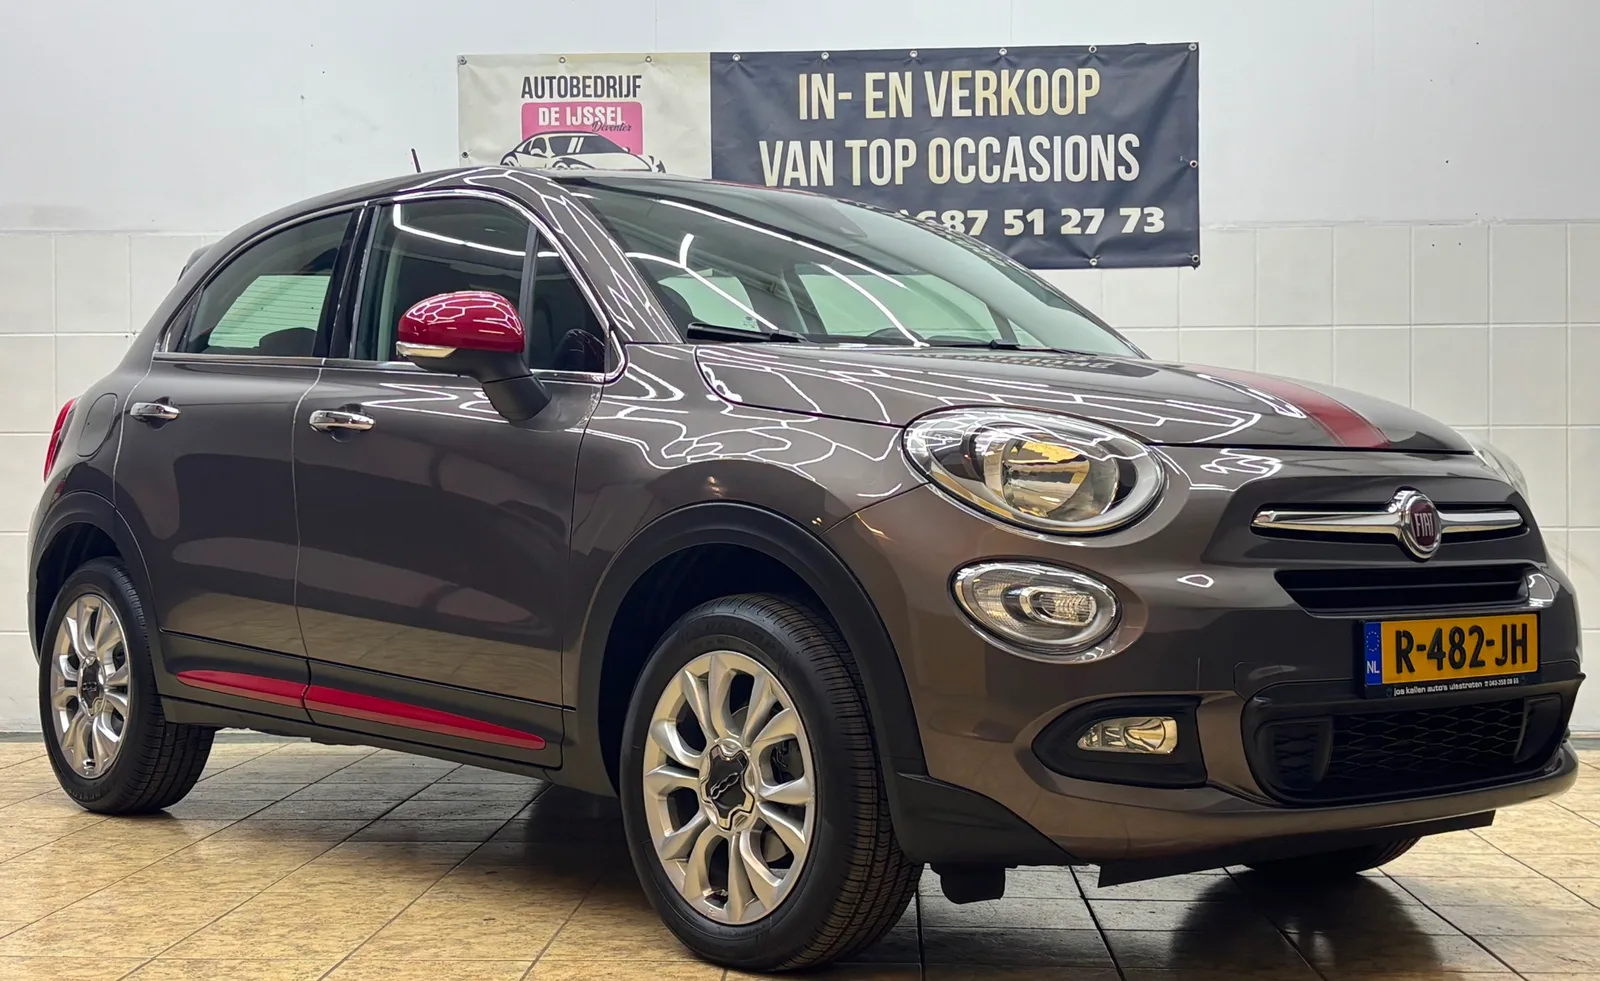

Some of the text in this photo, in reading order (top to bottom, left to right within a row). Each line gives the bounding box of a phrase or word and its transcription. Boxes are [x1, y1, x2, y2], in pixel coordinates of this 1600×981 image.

[521, 75, 642, 98] AUTOBEDRIJF
[798, 68, 1100, 120] IN- EN VERKOOP
[538, 106, 625, 126] DE IJSSEL
[591, 120, 632, 132] Deventer
[758, 134, 1140, 187] VAN TOP OCCASIONS
[1004, 208, 1045, 236] 51
[1060, 208, 1105, 235] 27
[1119, 206, 1166, 233] 73
[1414, 512, 1434, 537] FIAT
[1395, 623, 1528, 674] R-482-JH
[1366, 661, 1380, 674] NL
